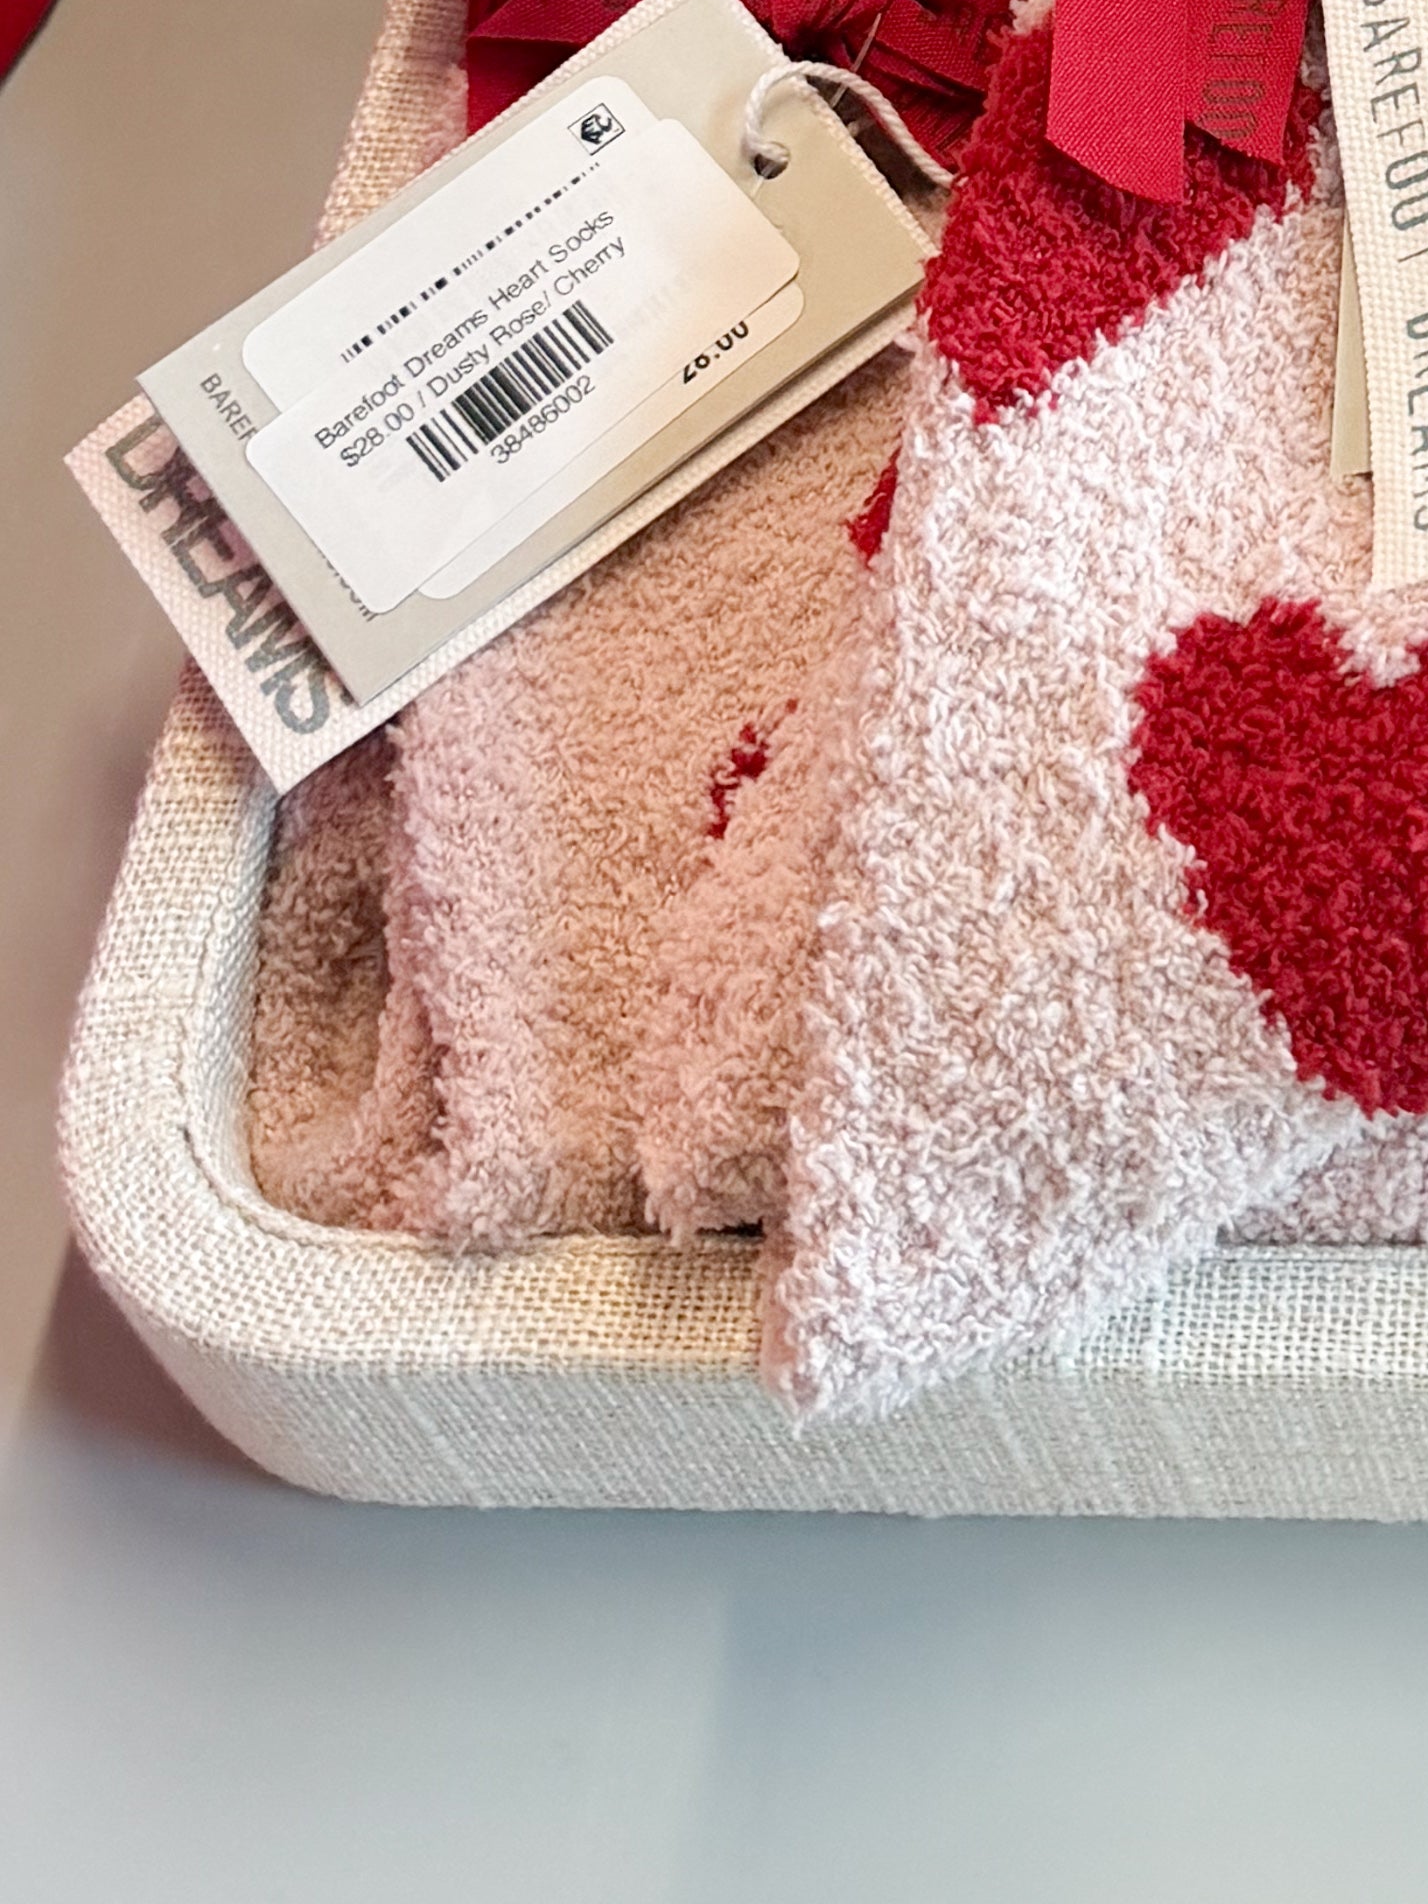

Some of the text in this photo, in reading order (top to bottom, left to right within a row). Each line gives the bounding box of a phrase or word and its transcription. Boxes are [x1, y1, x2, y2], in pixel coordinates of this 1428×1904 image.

[313, 372, 405, 450] Barefoot
[403, 305, 489, 379] Dreams
[488, 258, 550, 311] Heart
[548, 209, 615, 265] Socks
[339, 402, 415, 468] $28.00
[426, 344, 491, 398] Dusty
[553, 234, 627, 297] Cherry
[490, 374, 597, 466] 38486002
